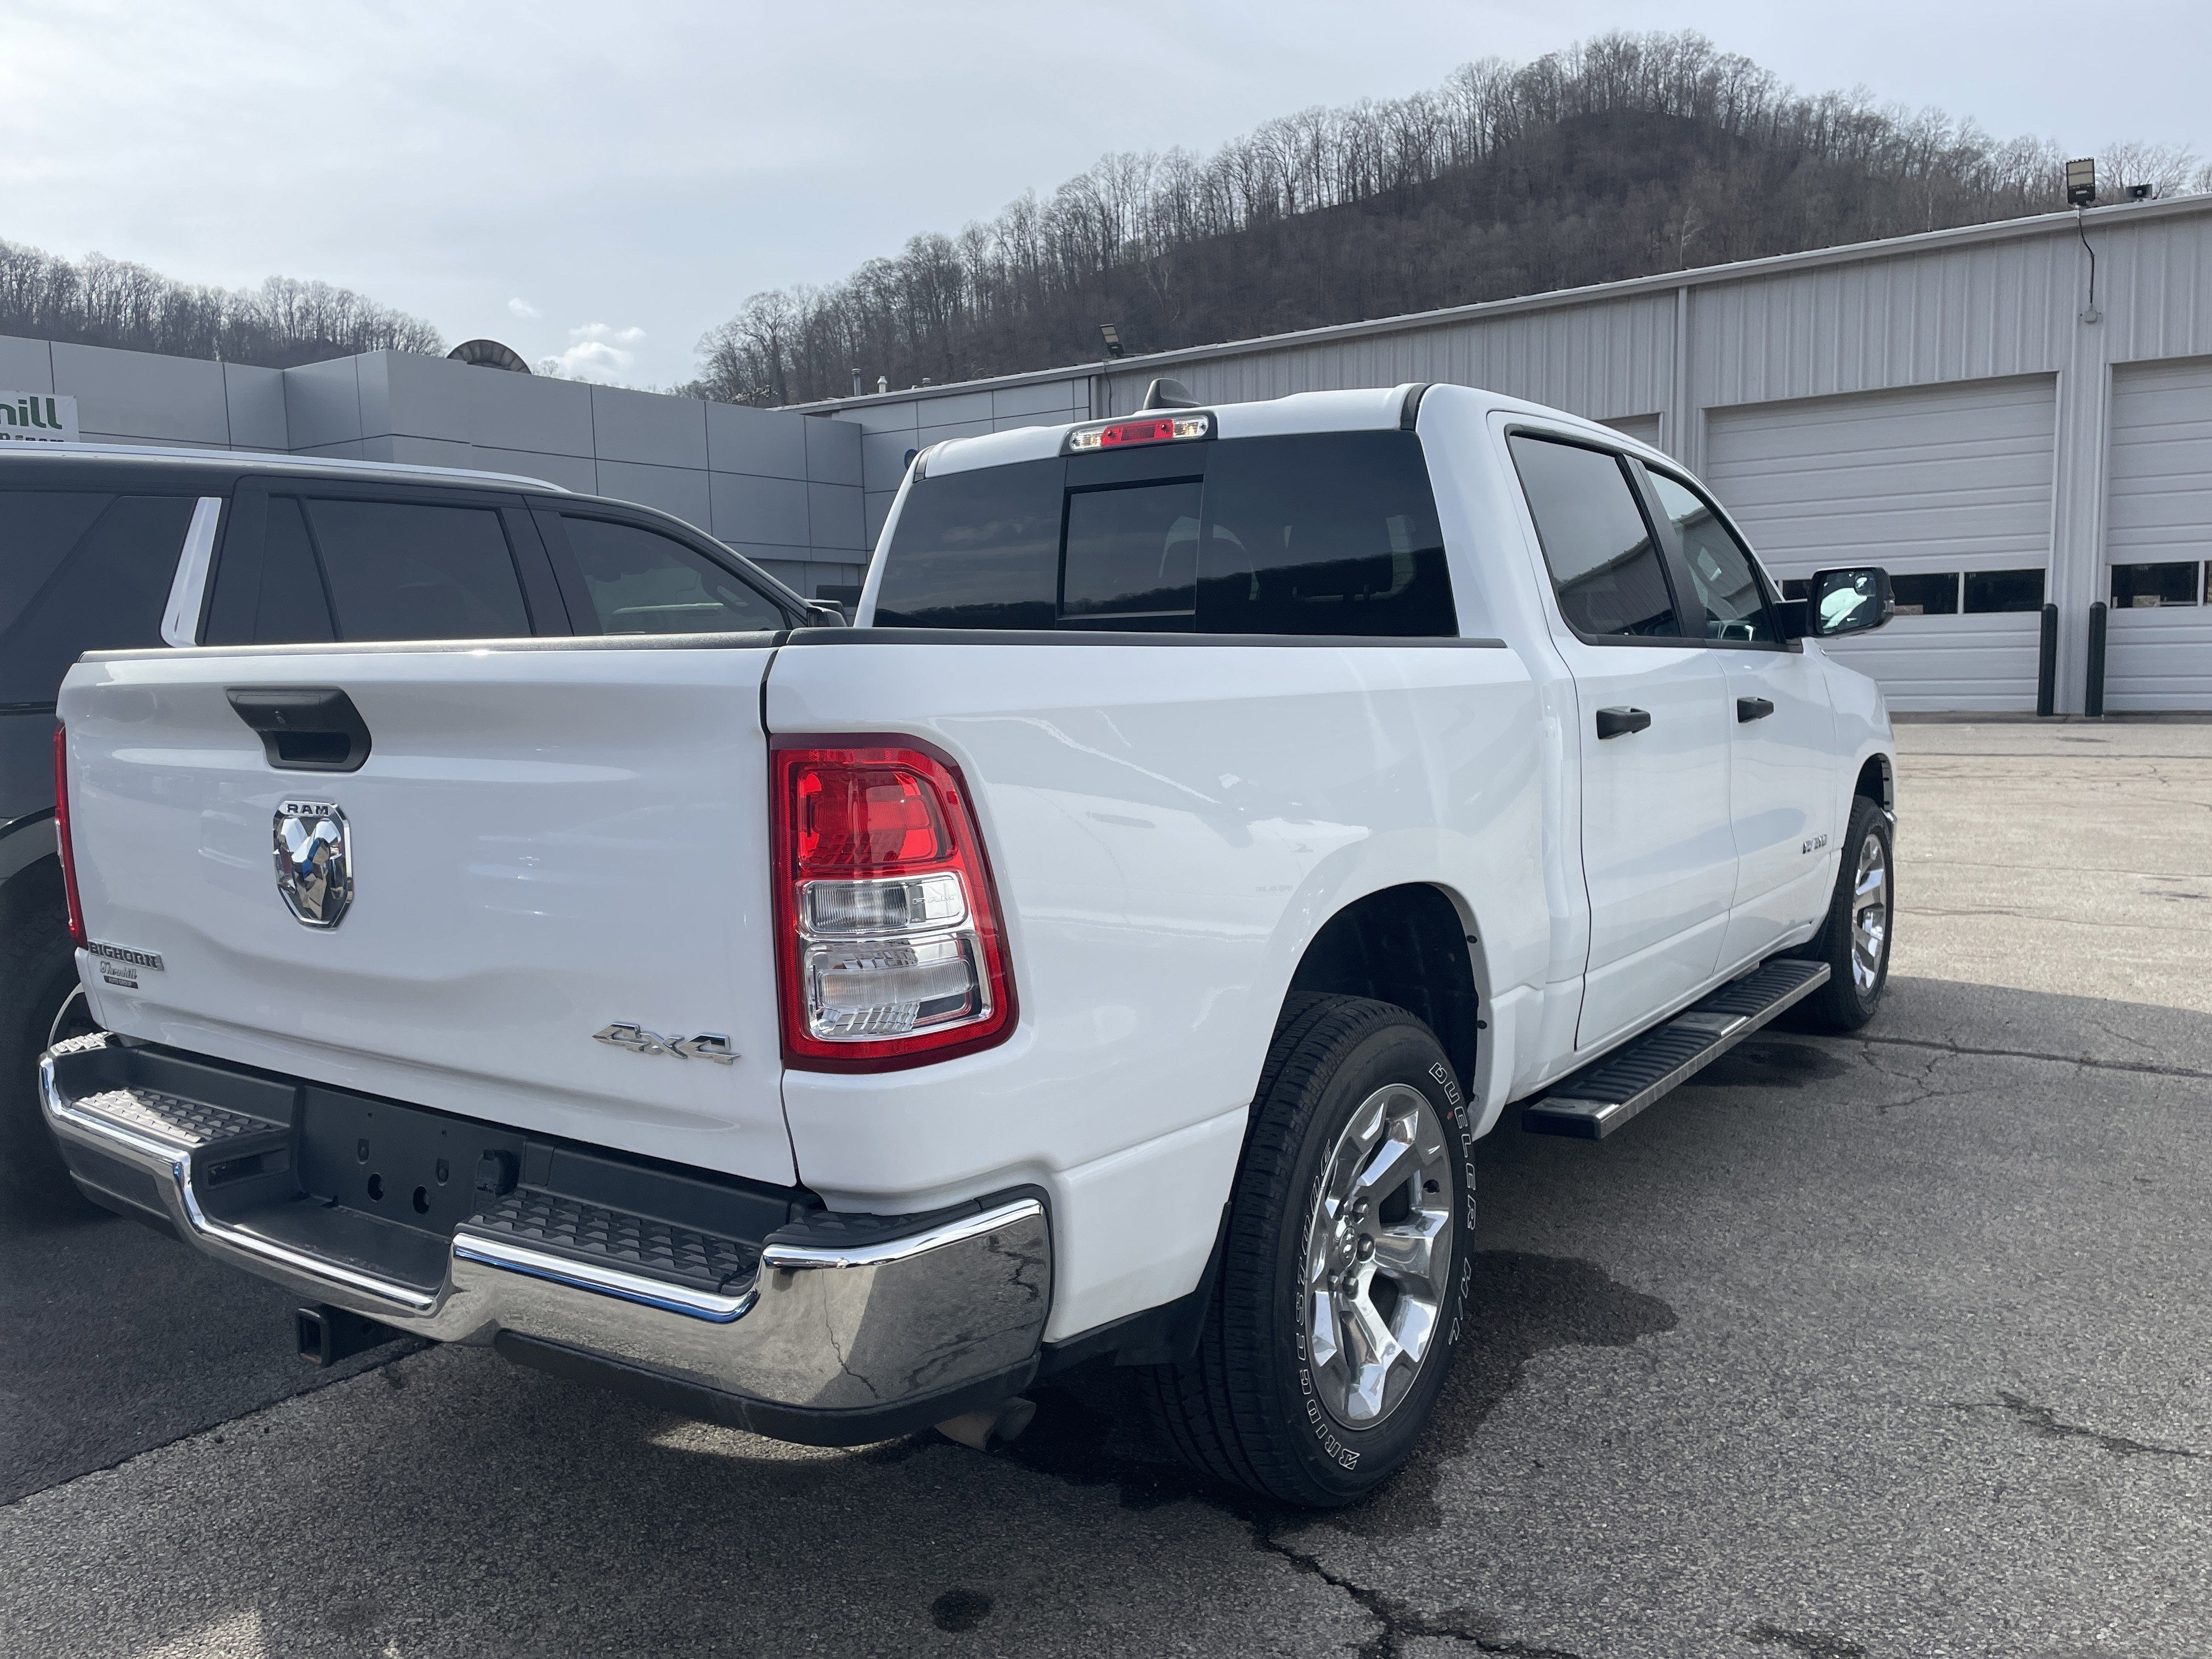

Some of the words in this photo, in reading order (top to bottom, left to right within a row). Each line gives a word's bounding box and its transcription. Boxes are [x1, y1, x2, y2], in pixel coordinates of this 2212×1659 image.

[287, 804, 329, 815] RAM
[1429, 1062, 1476, 1231] DUELER
[1295, 1138, 1361, 1470] BRIDGESTONE
